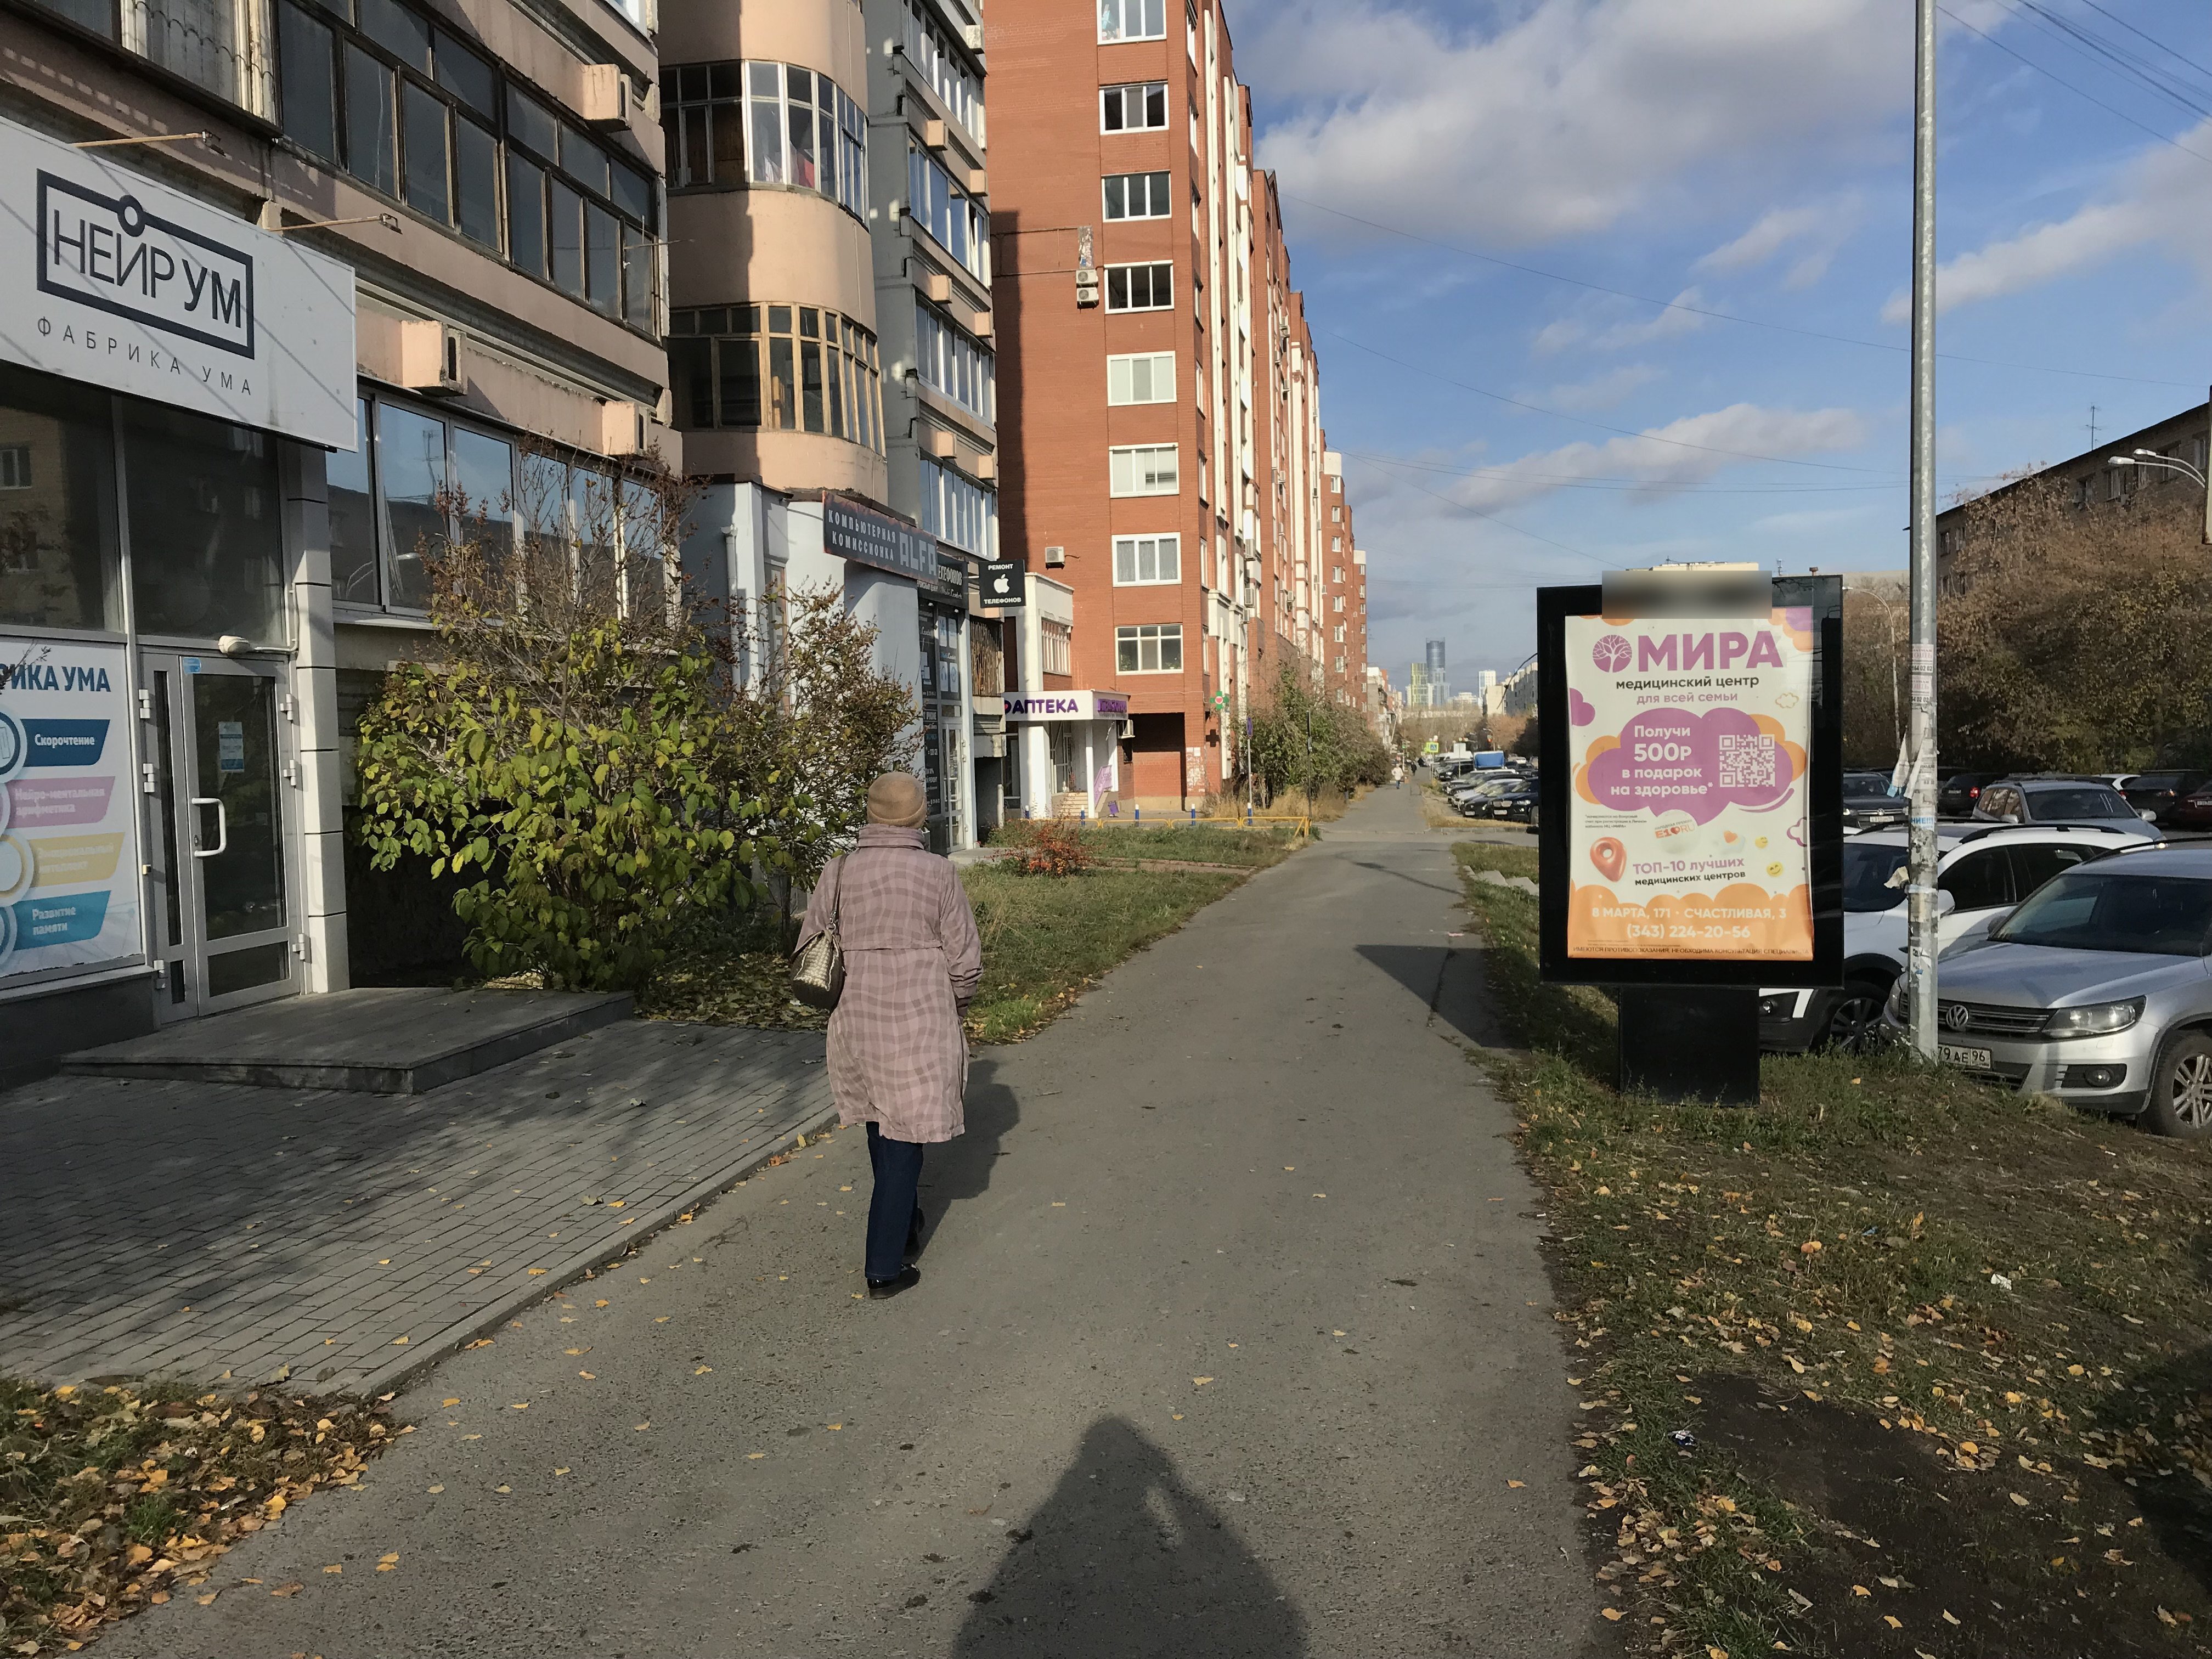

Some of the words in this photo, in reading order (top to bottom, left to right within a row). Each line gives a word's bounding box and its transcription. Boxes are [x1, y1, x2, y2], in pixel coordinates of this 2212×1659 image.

[37, 316, 180, 374] ФАБРИКА
[202, 365, 251, 395] УМА
[828, 509, 896, 543] КОМПЬЮТЕРНАЯ
[832, 531, 894, 561] КОМИССИОНКА
[899, 532, 937, 576] ALFA
[938, 565, 963, 586] ЕЛЕФОНОВ
[1638, 630, 1784, 672] МИРА
[61, 666, 111, 692] УМА
[1616, 676, 1712, 690] медицинский
[1716, 676, 1759, 689] центр
[1012, 698, 1079, 714] АПТЕКА
[1637, 695, 1660, 705] для
[1664, 692, 1694, 703] всей
[1698, 693, 1738, 702] семьи
[1634, 725, 1690, 740] Получи
[35, 733, 95, 748] Скорочтение
[1622, 769, 1630, 778] в
[1634, 768, 1702, 780] подарок
[1611, 786, 1630, 795] на
[1633, 860, 1686, 874] ТОП-10
[1690, 858, 1745, 872] лучших
[1635, 874, 1701, 885] медицинских
[1704, 871, 1746, 881] центров
[32, 906, 76, 921] Развитие
[1592, 908, 1599, 917] 8
[1603, 907, 1650, 919] МАРТА,
[1653, 908, 1671, 918] 171
[1684, 908, 1775, 919] СЧАСТЛИВАЯ,
[1779, 908, 1786, 918] 3
[33, 922, 68, 935] памяти
[1627, 924, 1664, 939] (343)
[1669, 925, 1751, 938] 224-20-56
[1972, 1051, 1985, 1062] 96
